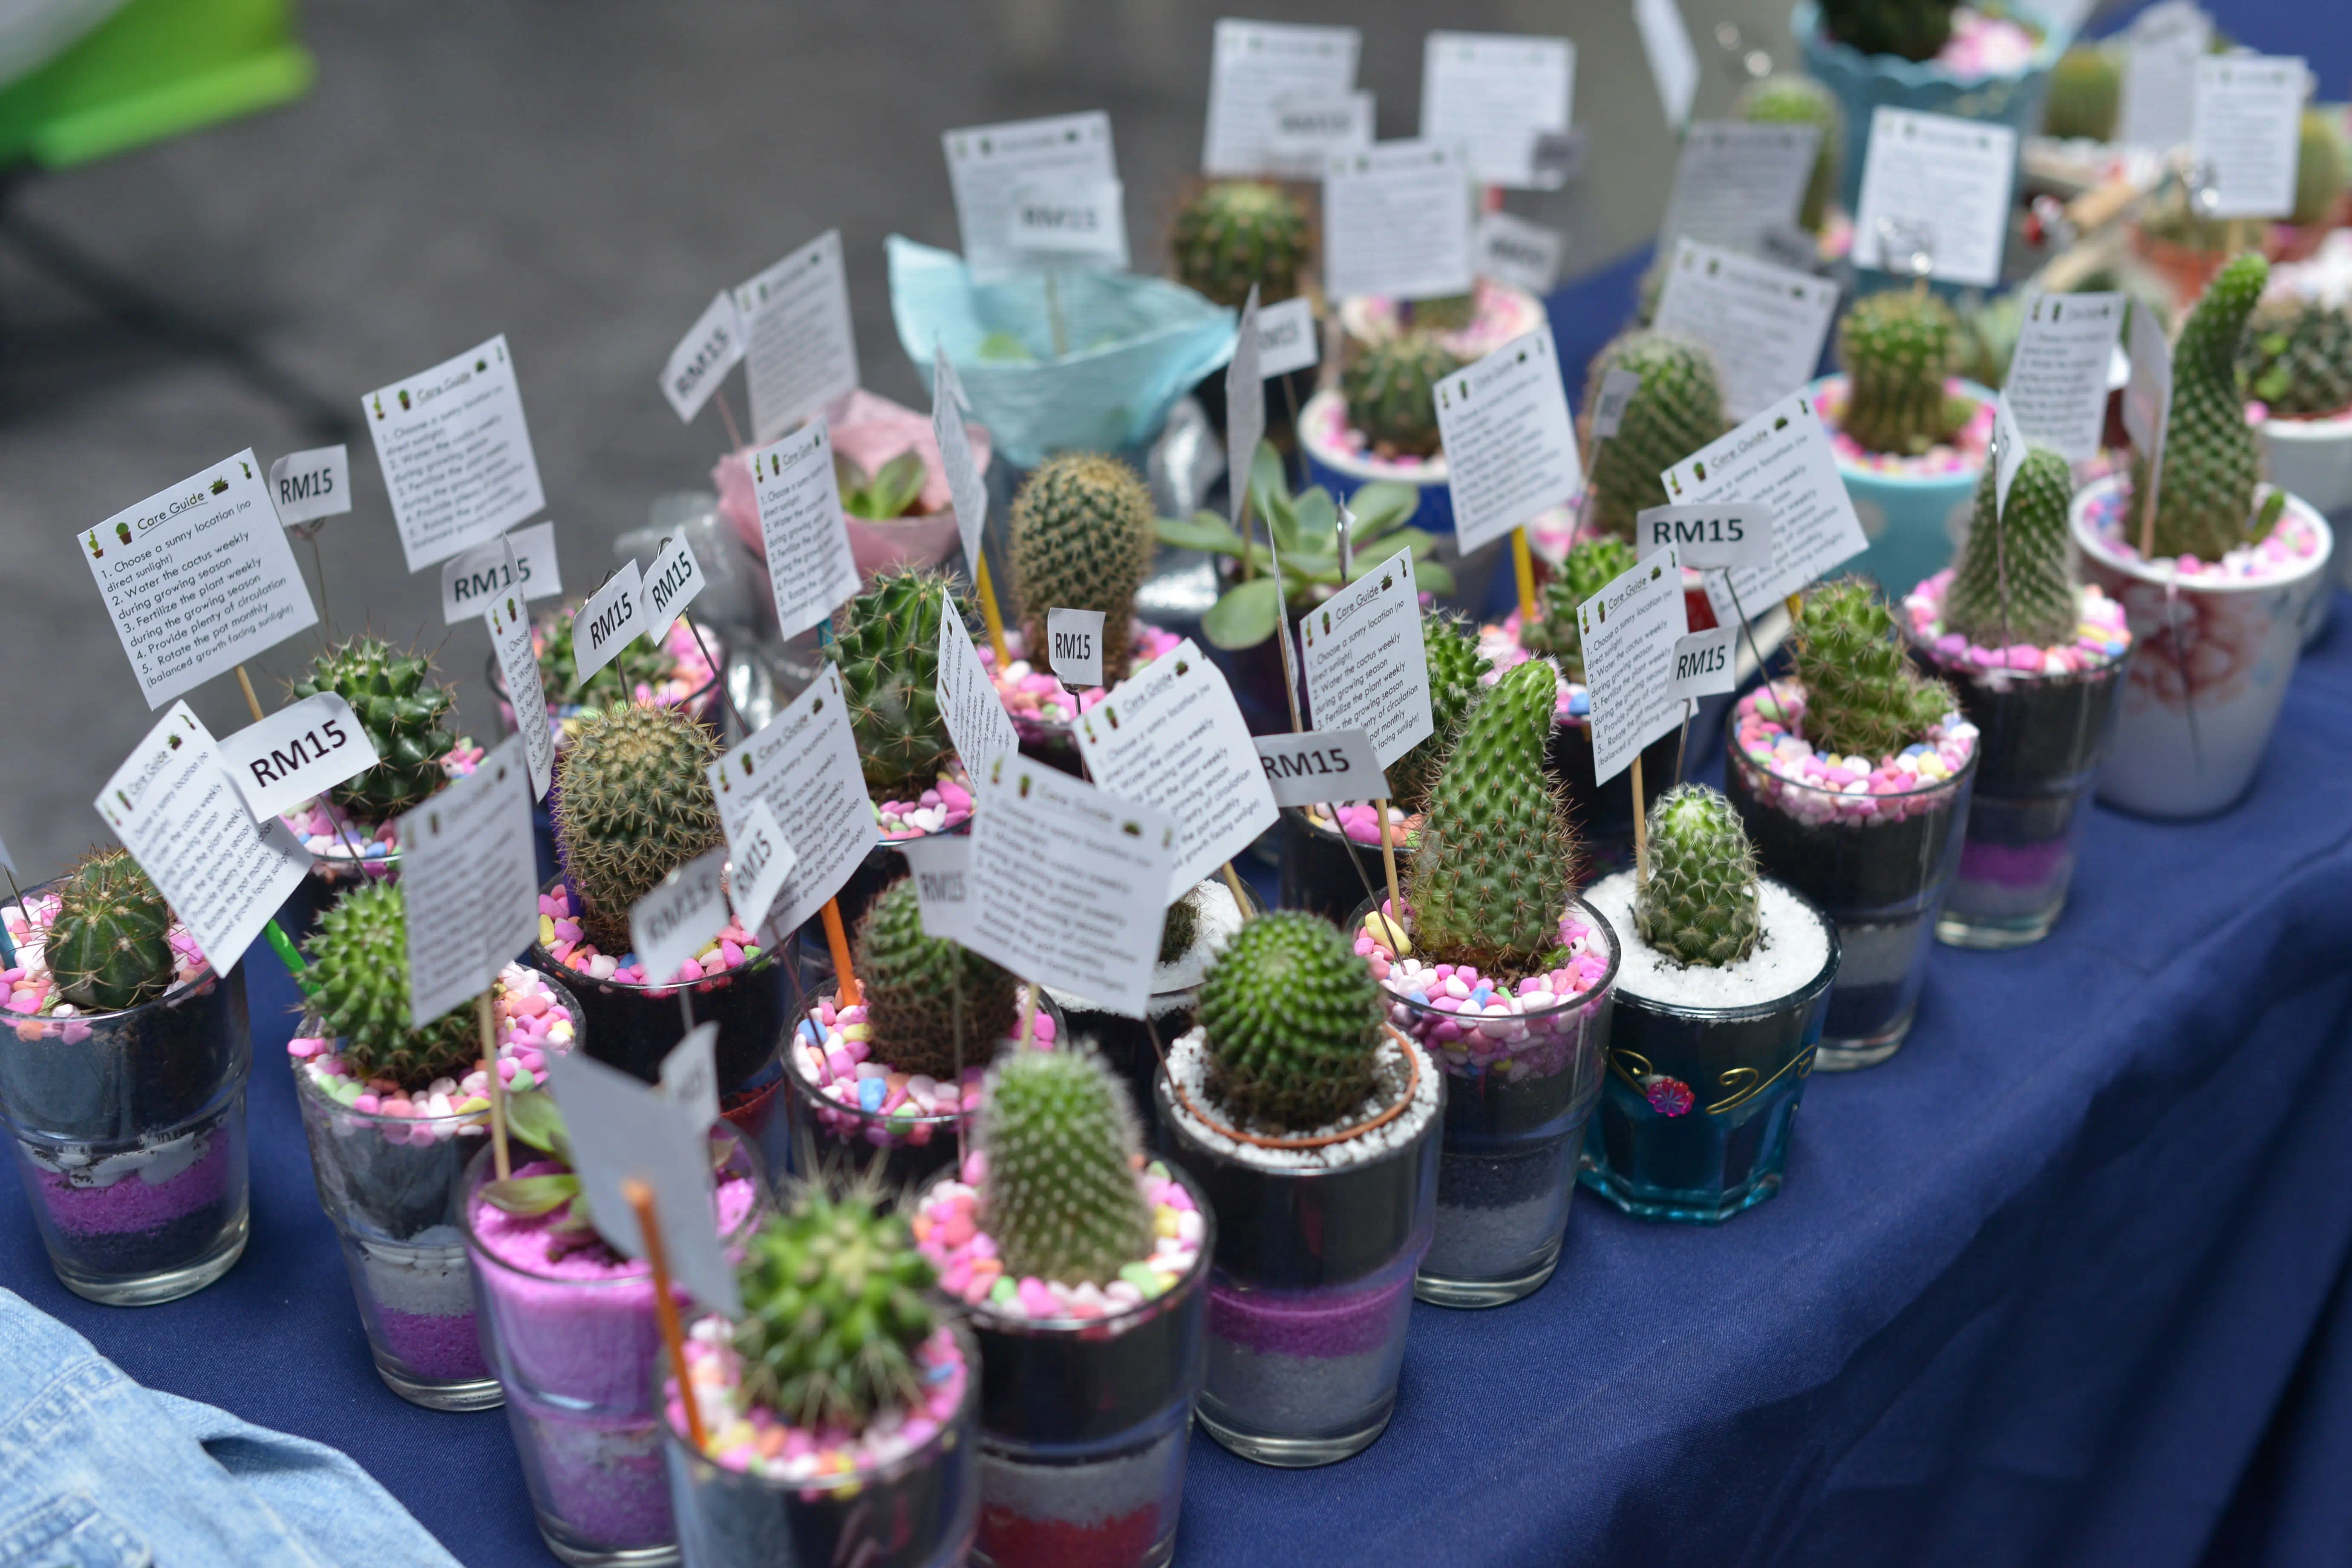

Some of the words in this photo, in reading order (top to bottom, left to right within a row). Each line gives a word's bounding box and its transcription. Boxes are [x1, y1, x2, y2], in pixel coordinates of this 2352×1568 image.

[674, 325, 729, 399] RM15
[137, 512, 166, 530] Care
[169, 493, 204, 514] Guide
[280, 468, 333, 505] RM15
[101, 570, 112, 579] 1.
[114, 551, 152, 572] Choose
[165, 529, 191, 548] sunny
[194, 508, 234, 533] location
[236, 500, 251, 513] (no
[1653, 519, 1744, 545] RM15
[107, 574, 133, 592] direct
[135, 553, 173, 578] sunlight)
[112, 596, 123, 606] 2.
[124, 577, 159, 598] Water
[162, 568, 179, 580] the
[182, 551, 212, 571] cactus
[214, 532, 248, 553] weekly
[118, 599, 151, 619] during
[154, 576, 196, 603] growing
[198, 558, 231, 579] season
[123, 623, 135, 633] 3.
[136, 602, 177, 627] Fertilize
[179, 593, 196, 605] the
[199, 576, 224, 597] plant
[227, 558, 260, 579] weekly
[455, 557, 530, 602] RM15
[652, 551, 692, 613] RM15
[1608, 593, 1624, 609] Care
[1626, 577, 1646, 597] Guide
[130, 626, 163, 647] during
[164, 617, 181, 628] the
[184, 594, 225, 621] growing
[227, 575, 260, 597] season
[136, 650, 146, 659] 4.
[148, 630, 187, 654] Provide
[190, 611, 220, 634] plenty
[224, 601, 234, 614] of
[238, 578, 286, 607] circulation
[590, 592, 632, 650] RM15
[1336, 603, 1354, 620] Care
[1356, 586, 1378, 605] Guide
[1586, 647, 1592, 656] 1.
[1594, 631, 1613, 651] Choose
[1620, 613, 1635, 630] sunny
[1636, 596, 1662, 616] location
[1663, 589, 1672, 601] (no
[142, 663, 152, 674] 5.
[157, 644, 191, 666] Rotate
[193, 635, 209, 646] the
[212, 623, 228, 639] pot
[231, 603, 268, 627] monthly
[147, 656, 193, 688] (balanced
[196, 640, 226, 663] growth
[228, 625, 256, 643] facing
[258, 604, 293, 628] sunlight)
[1055, 633, 1091, 660] RM15
[1317, 644, 1340, 665] Choose
[1342, 639, 1347, 647] a
[1349, 625, 1366, 643] sunny
[1368, 607, 1393, 629] location
[1395, 600, 1404, 613] (no
[1588, 653, 1603, 670] direct
[1604, 635, 1622, 657] sunlight)
[1589, 673, 1596, 684] 2.
[1597, 659, 1615, 677] Water
[1616, 651, 1624, 661] the
[1625, 636, 1643, 654] cactus
[1644, 620, 1667, 638] weekly
[1311, 668, 1327, 685] direct
[1329, 649, 1352, 672] sunlight)
[1315, 695, 1336, 715] during
[1337, 675, 1364, 701] growing
[1365, 658, 1387, 679] season
[1320, 673, 1343, 692] Water
[1344, 666, 1355, 677] the
[1356, 650, 1376, 669] cactus
[1378, 632, 1400, 653] weekly
[1591, 680, 1610, 698] during
[1611, 660, 1631, 684] growing
[1632, 644, 1653, 663] season
[1593, 702, 1599, 712] 3.
[1600, 684, 1622, 706] Fertilize
[1622, 676, 1630, 686] the
[1631, 662, 1646, 681] plant
[1648, 648, 1670, 665] weekly
[1676, 645, 1726, 680] RM15
[1325, 701, 1351, 723] Fertilize
[1352, 693, 1363, 704] the
[1364, 678, 1381, 698] plant
[1383, 661, 1405, 682] weekly
[1342, 717, 1352, 728] the
[1354, 696, 1380, 722] growing
[1381, 680, 1403, 700] season
[1360, 715, 1377, 730] lenty
[1378, 705, 1385, 718] of
[1386, 685, 1418, 712] circulation
[1594, 707, 1614, 726] during
[1614, 699, 1623, 710] the
[1623, 679, 1644, 703] growing
[1646, 664, 1668, 682] season
[1596, 730, 1602, 739] 4.
[1603, 712, 1625, 735] Provide
[1626, 697, 1640, 717] plenty
[1642, 688, 1649, 700] of
[250, 719, 347, 788] RM15
[1369, 727, 1379, 744] pot
[1381, 709, 1405, 732] monthly
[1378, 732, 1395, 749] facing
[1397, 712, 1419, 735] sunlight)
[1597, 744, 1603, 754] 5.
[1607, 728, 1626, 747] Rotate
[1260, 748, 1350, 779] RM15
[1598, 741, 1626, 768] (balanced
[230, 824, 252, 850] season
[245, 822, 274, 858] circulation
[735, 829, 772, 899] RM15
[646, 872, 713, 943] RM15
